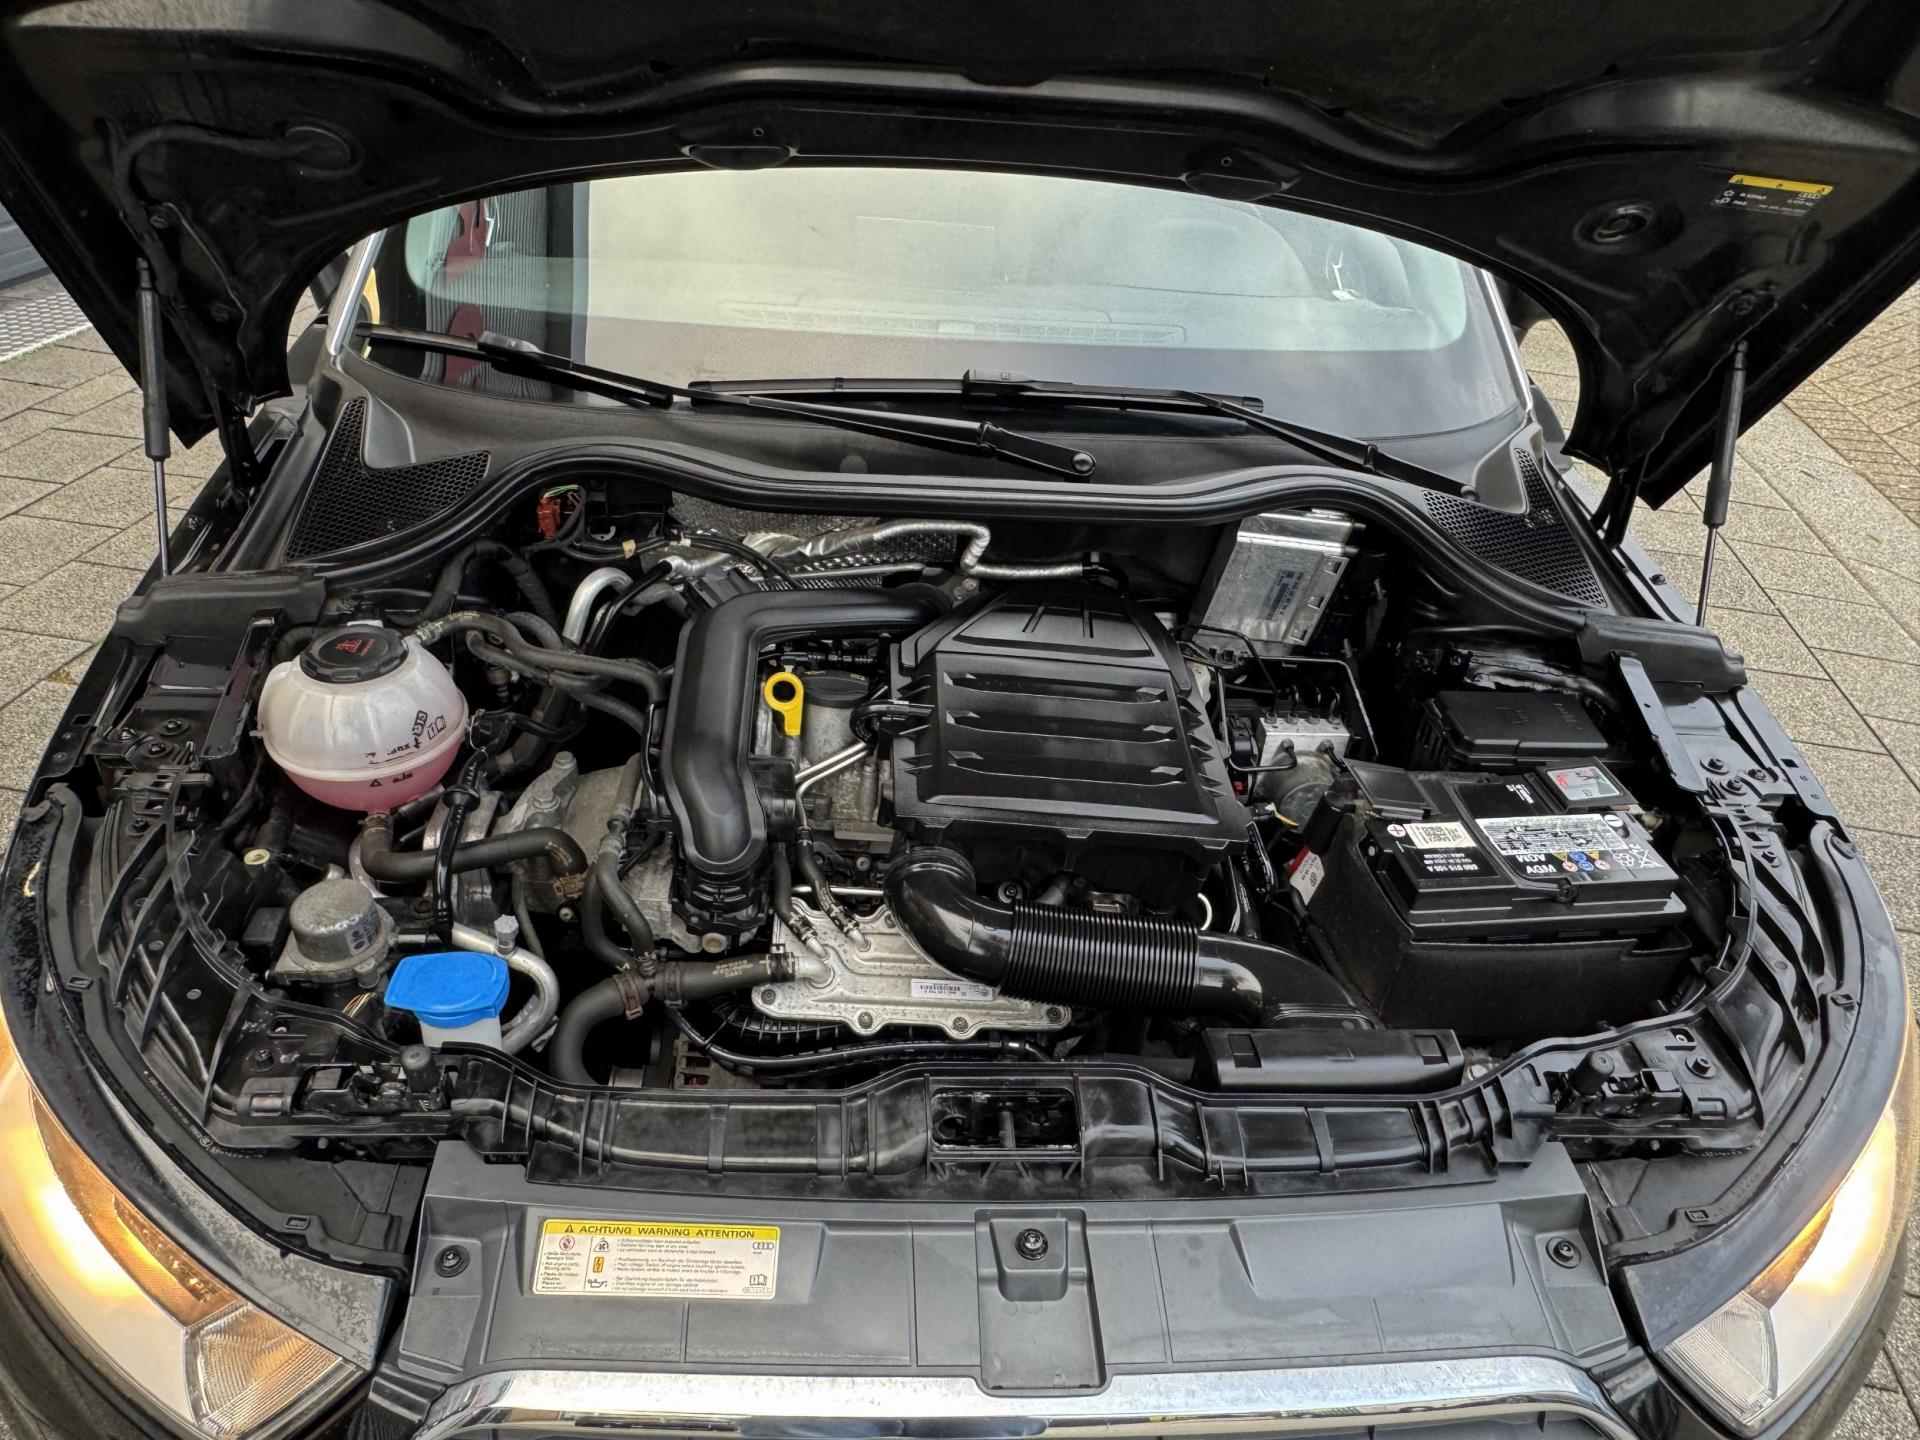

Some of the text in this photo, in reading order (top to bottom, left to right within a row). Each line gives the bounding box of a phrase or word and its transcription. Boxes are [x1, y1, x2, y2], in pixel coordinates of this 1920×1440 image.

[1515, 853, 1546, 862] AGM
[1526, 864, 1557, 874] AGM
[580, 1225, 755, 1238] ACHTUNG WARNING ATTENTION
